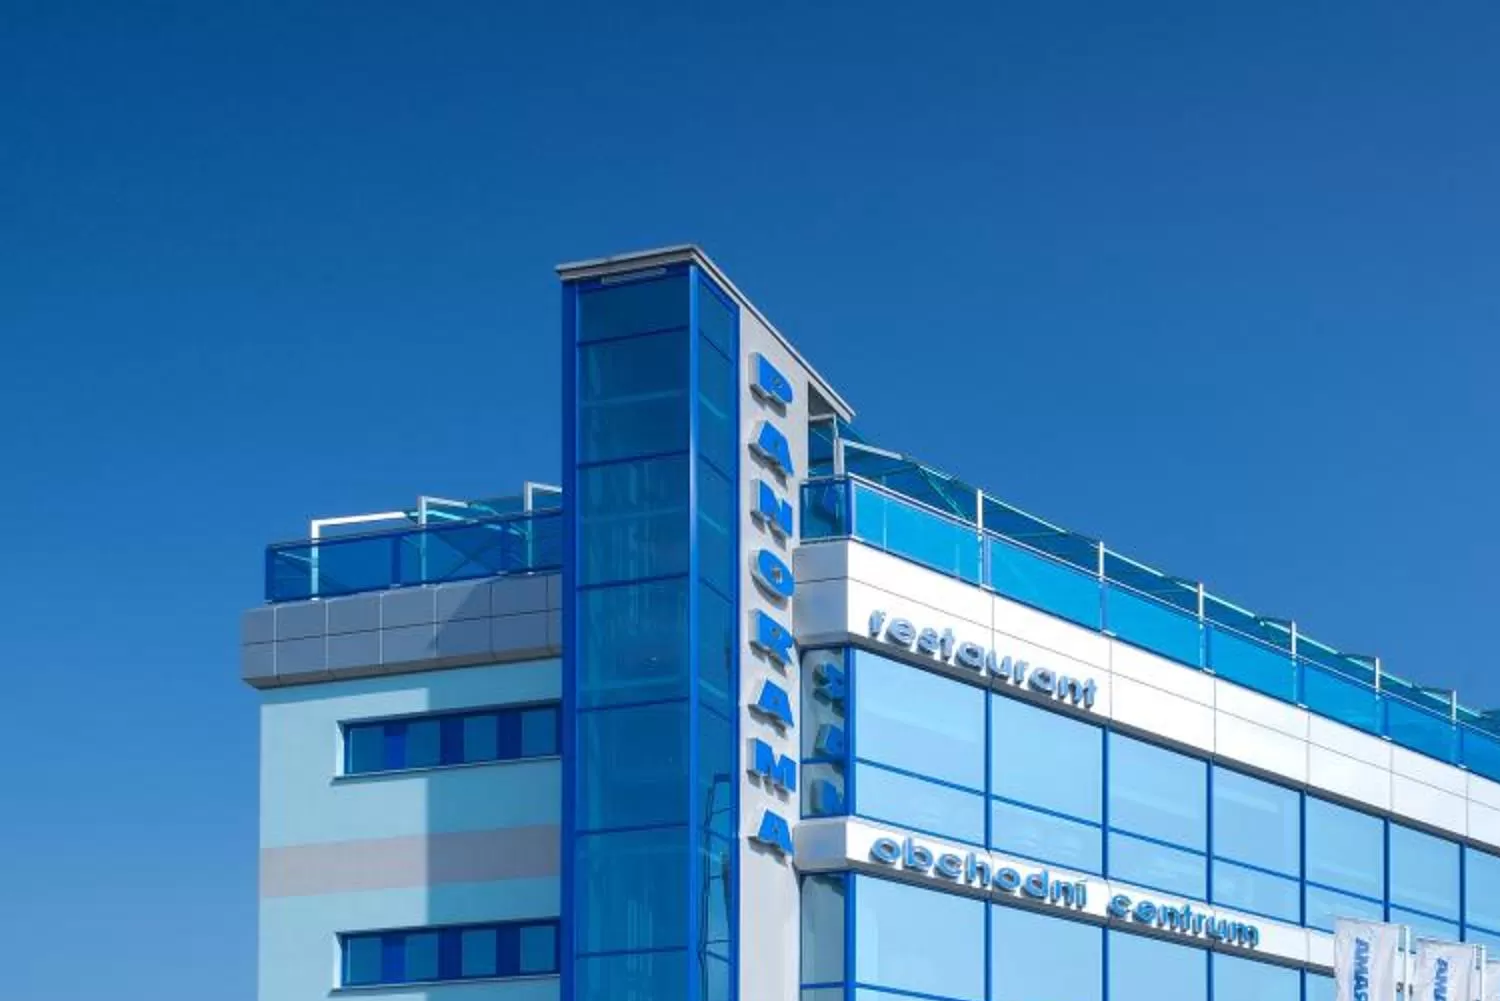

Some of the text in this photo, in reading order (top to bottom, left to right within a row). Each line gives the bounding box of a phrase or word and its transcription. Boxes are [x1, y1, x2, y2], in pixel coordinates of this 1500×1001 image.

[748, 352, 796, 857] PANORAMA
[868, 608, 1097, 709] restaurant
[870, 836, 1259, 948] obchodní centrum
